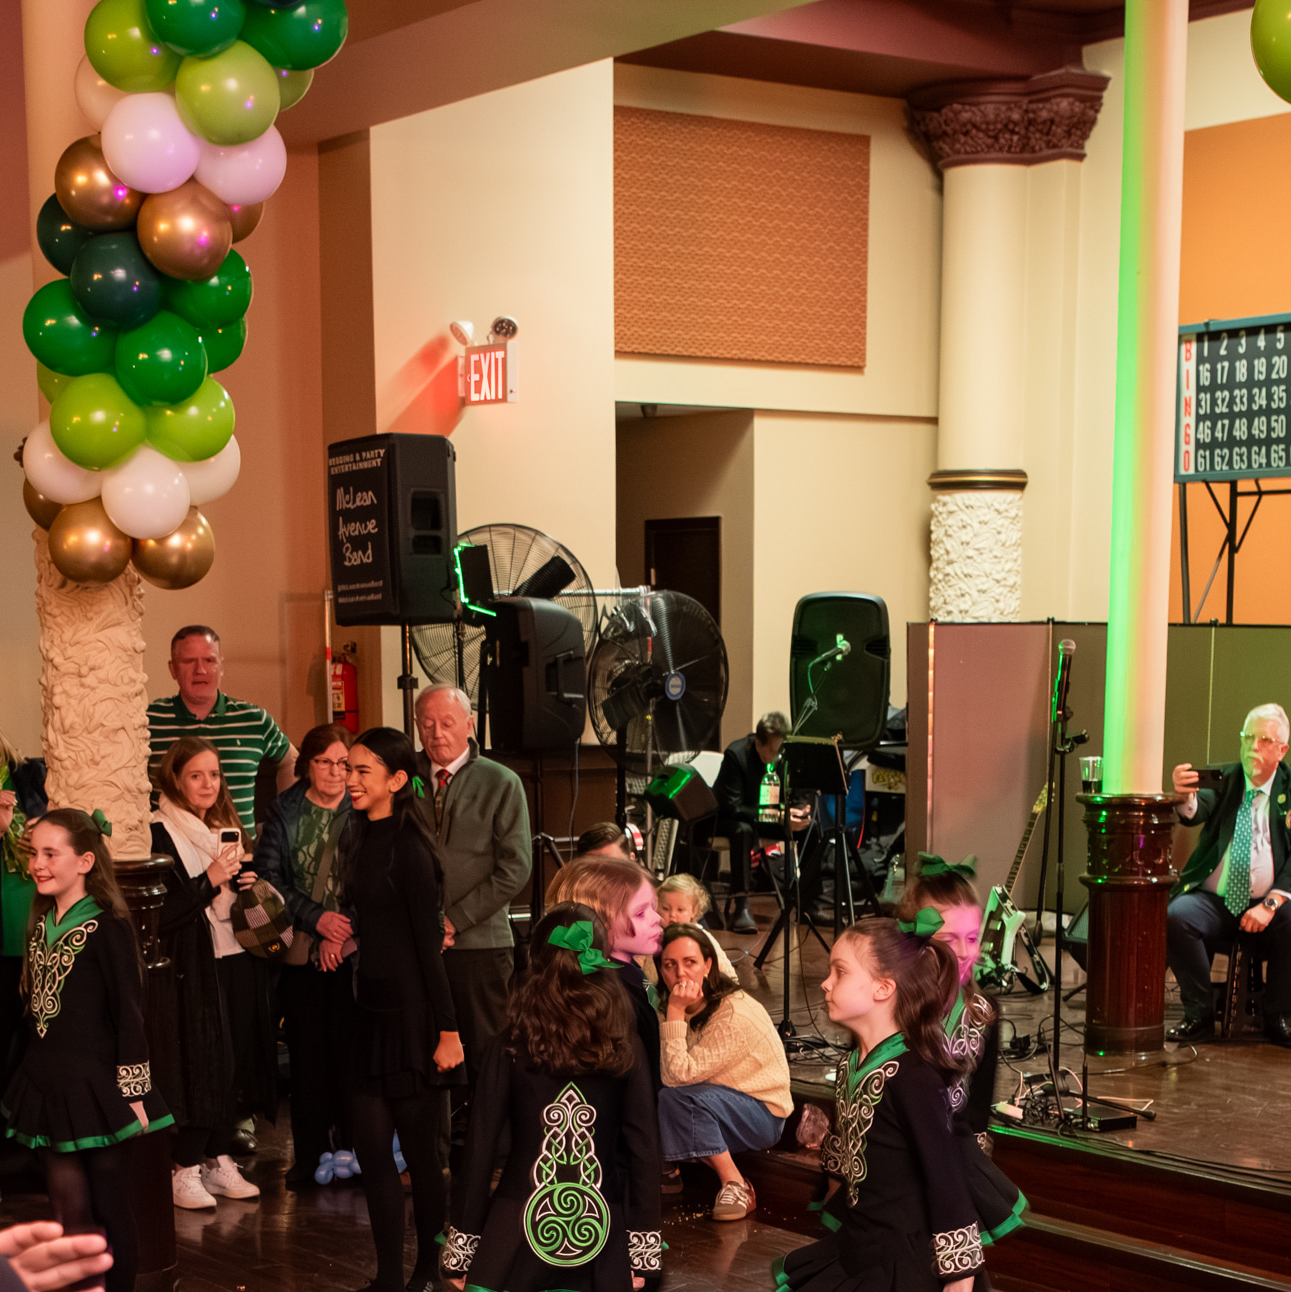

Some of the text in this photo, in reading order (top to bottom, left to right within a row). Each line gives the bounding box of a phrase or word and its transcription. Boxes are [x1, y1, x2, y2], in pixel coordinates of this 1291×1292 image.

[1220, 332, 1228, 355] 2
[1238, 330, 1246, 354] 3
[1257, 328, 1266, 350] 4
[1277, 326, 1284, 349] 5
[470, 350, 505, 402] EXIT
[1199, 363, 1210, 386] 16
[1217, 361, 1229, 384] 17
[1235, 359, 1247, 382] 18
[1254, 357, 1266, 381] 19
[1271, 355, 1287, 379] 20
[1199, 392, 1210, 415] 31
[1215, 390, 1229, 413] 32
[1233, 388, 1247, 412] 33
[1252, 387, 1267, 410] 34
[1271, 385, 1286, 409] 35
[1197, 421, 1211, 443] 46
[1215, 419, 1229, 442] 47
[1233, 418, 1247, 440] 48
[1252, 416, 1266, 439] 49
[1271, 415, 1286, 438] 50
[362, 449, 385, 460] PARTY
[1197, 449, 1210, 471] 61
[1214, 449, 1229, 471] 62
[1233, 447, 1247, 469] 63
[1252, 446, 1266, 468] 64
[1271, 444, 1285, 467] 65
[336, 486, 377, 511] McLean
[338, 518, 378, 543] Avenue
[342, 542, 373, 567] Band
